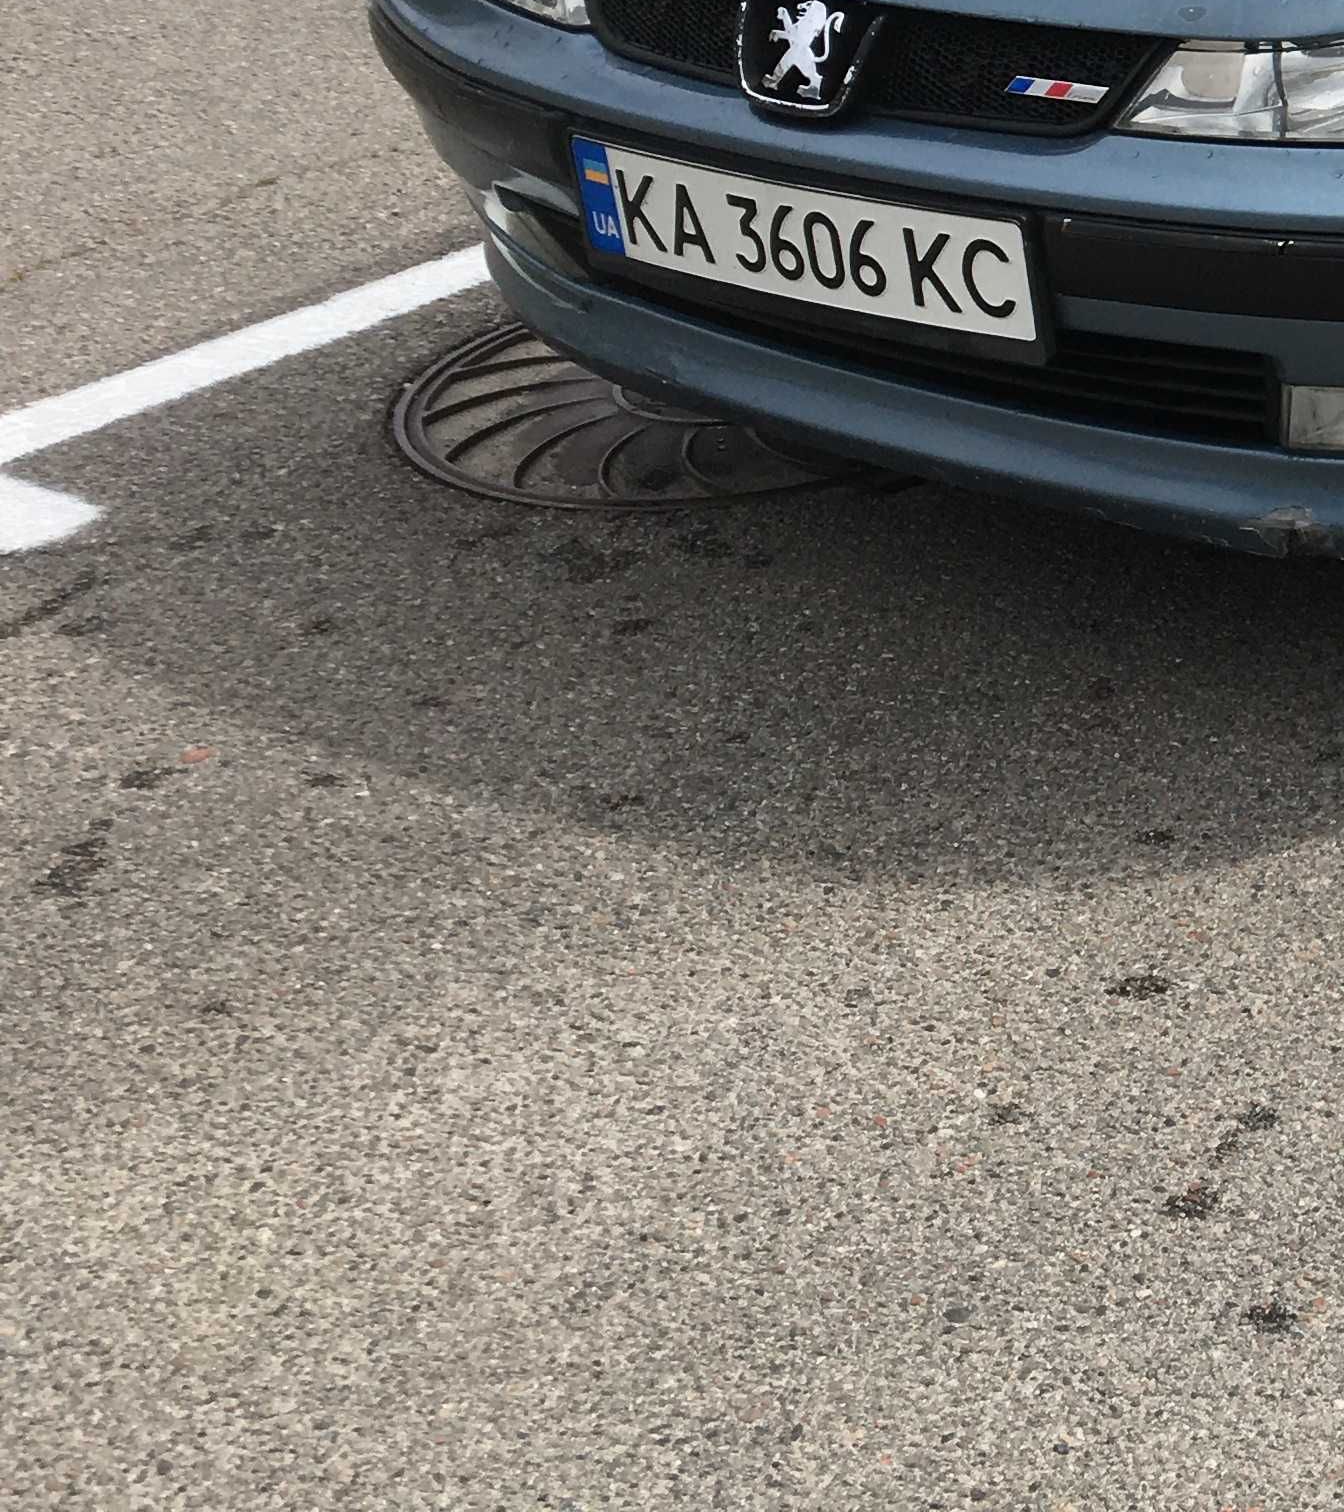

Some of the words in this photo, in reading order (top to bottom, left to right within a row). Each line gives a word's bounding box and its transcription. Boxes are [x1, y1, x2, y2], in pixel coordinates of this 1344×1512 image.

[591, 210, 620, 241] UA
[614, 167, 717, 265] KA
[725, 192, 888, 298] 3606
[902, 226, 1018, 319] KC
